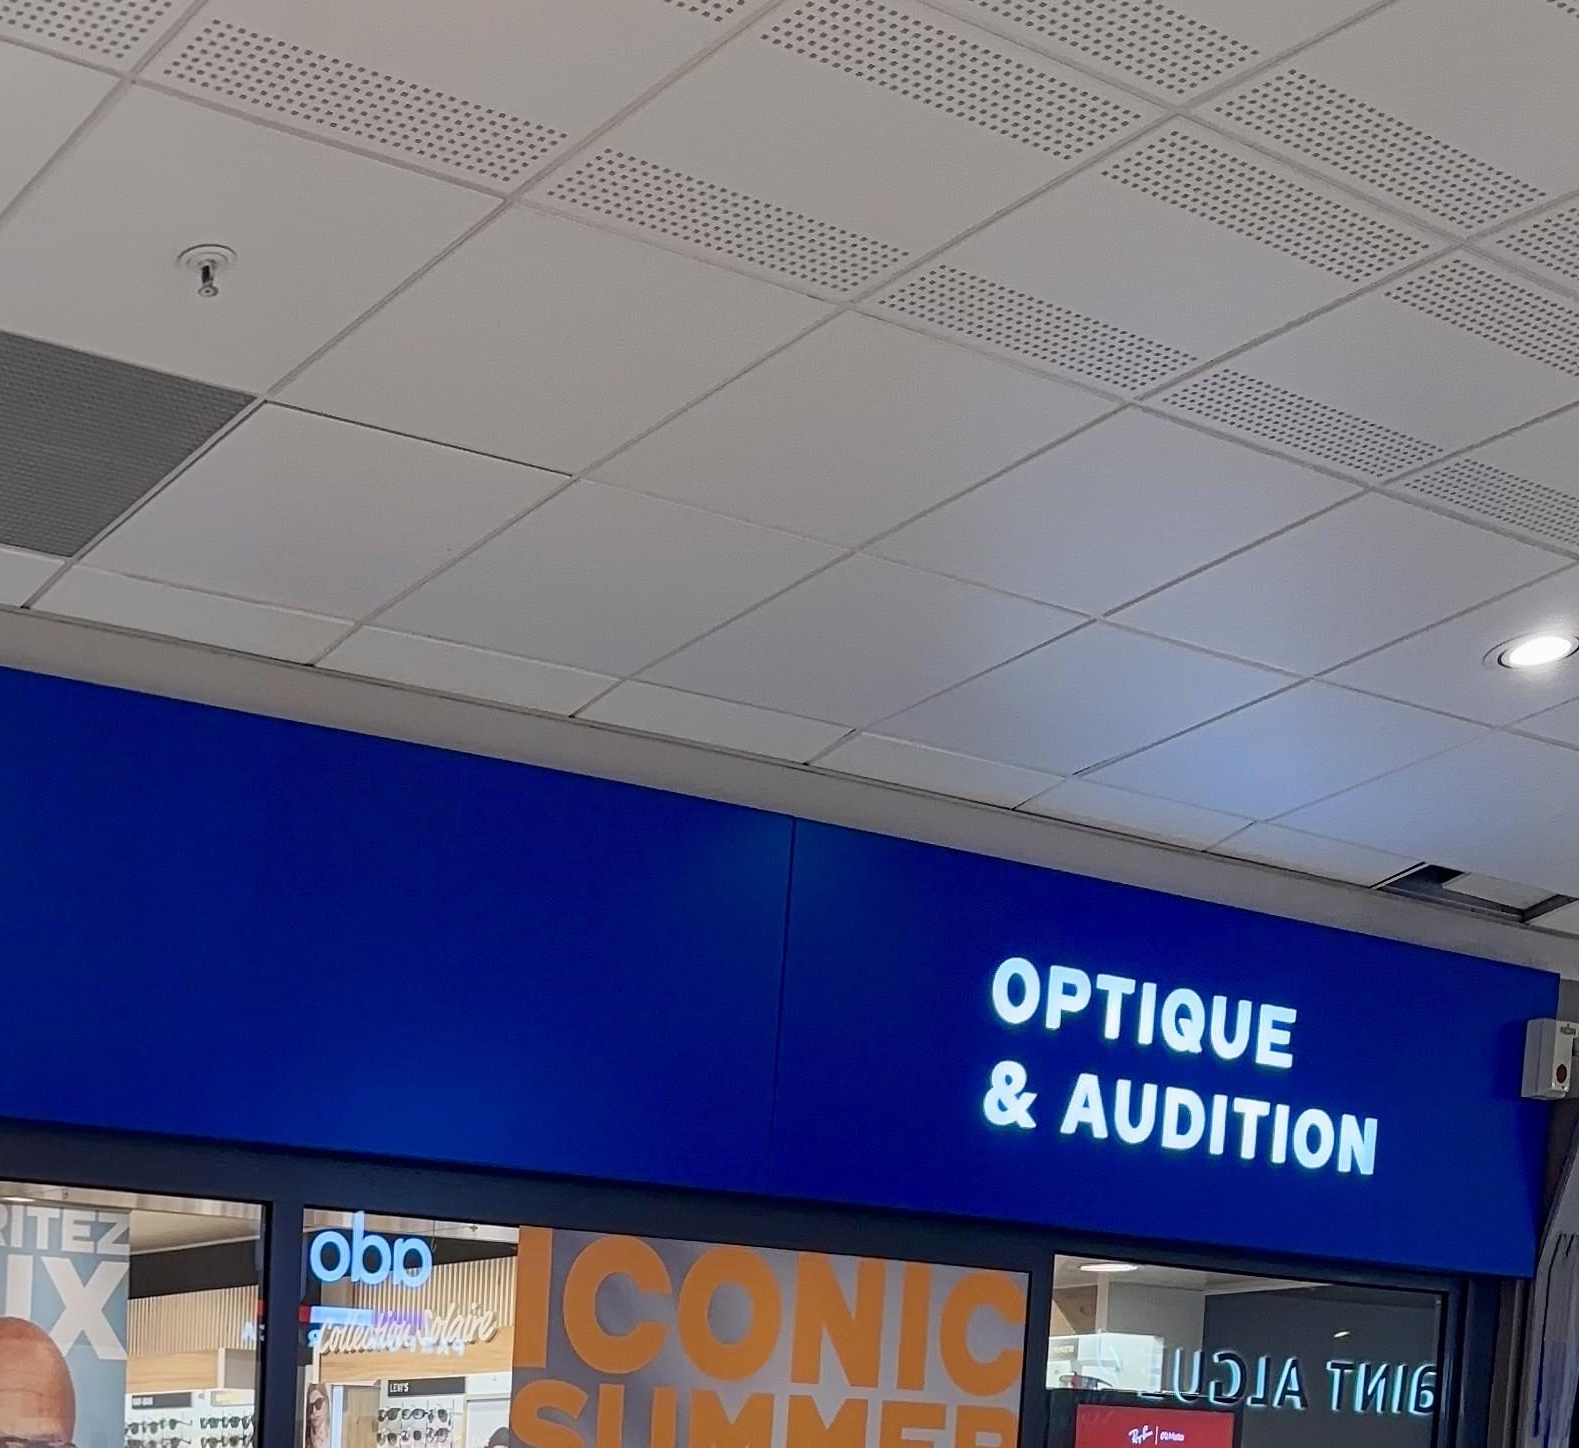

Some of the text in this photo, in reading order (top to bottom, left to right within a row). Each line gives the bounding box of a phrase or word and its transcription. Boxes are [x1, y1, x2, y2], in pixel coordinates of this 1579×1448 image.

[992, 956, 1298, 1069] OPTIQUE
[983, 1060, 1378, 1176] & AUDITION
[417, 1301, 498, 1344] Solaire
[511, 1226, 1029, 1397] ICONIC
